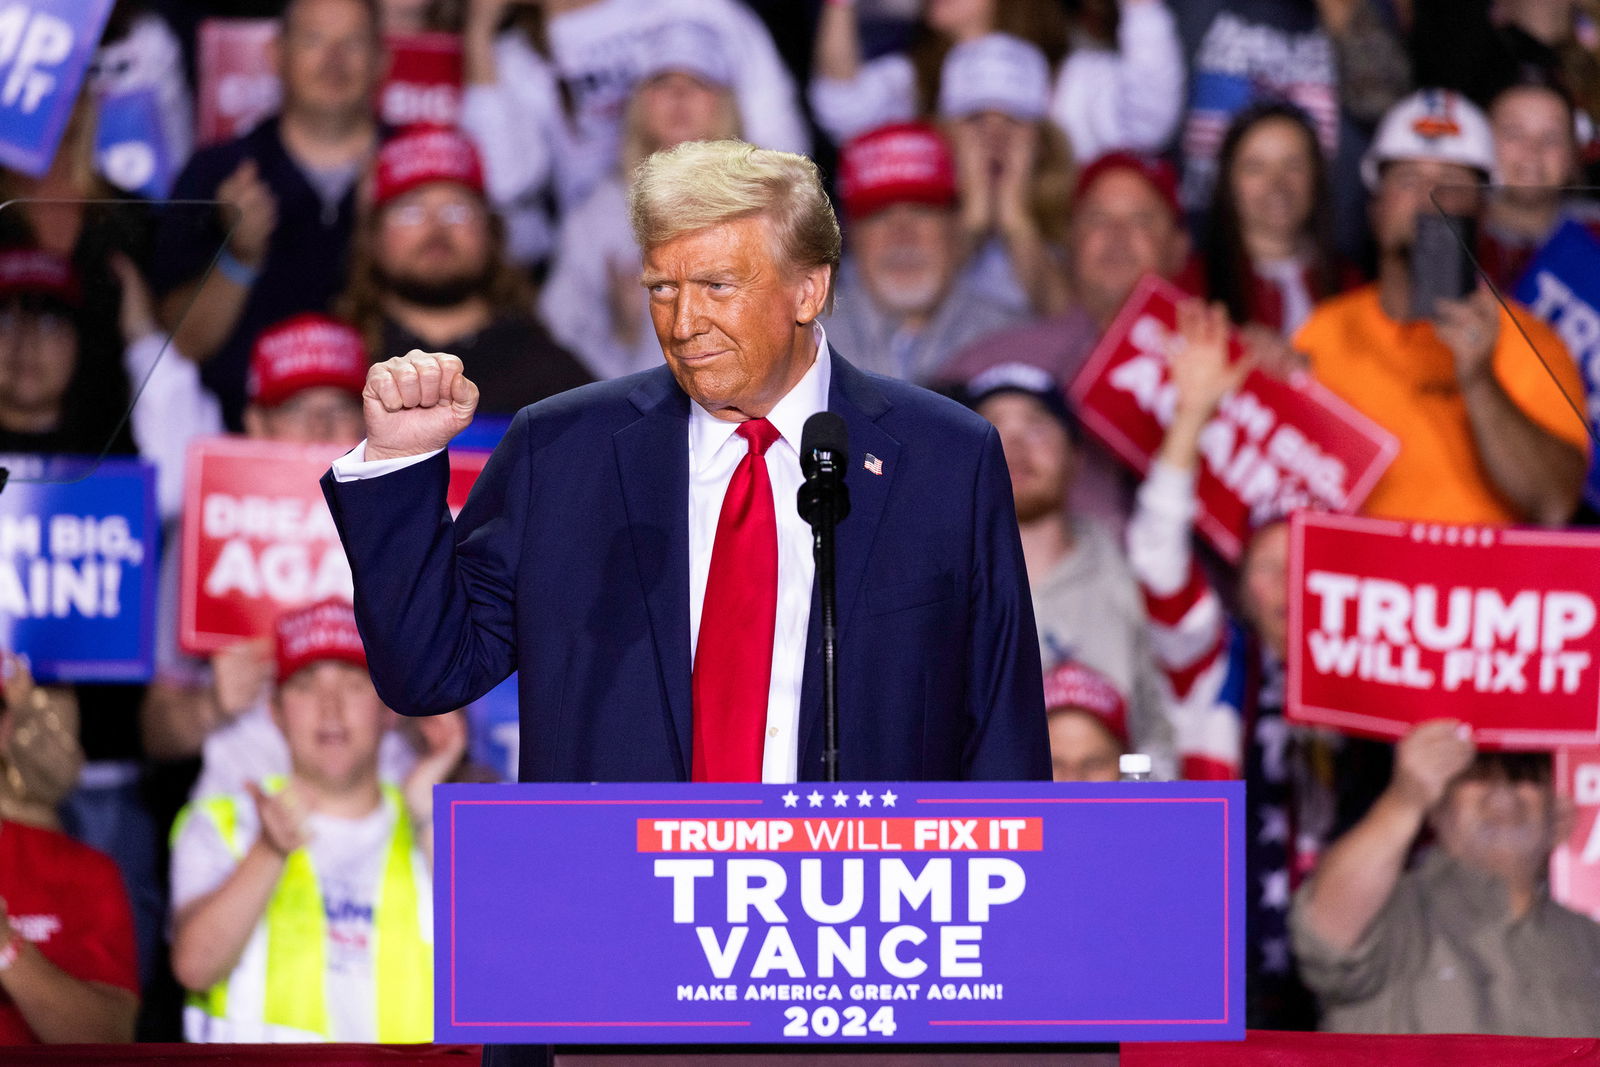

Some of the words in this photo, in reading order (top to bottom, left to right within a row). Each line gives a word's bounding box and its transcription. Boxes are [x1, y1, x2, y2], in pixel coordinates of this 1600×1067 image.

[49, 513, 145, 567] BIG,
[1305, 569, 1596, 653] TRUMP
[1307, 629, 1436, 690] WILL
[1442, 649, 1528, 694] FIX
[1537, 651, 1592, 694] IT
[653, 820, 794, 851] TRUMP
[803, 820, 902, 851] WILL
[914, 819, 979, 850] FIX
[989, 819, 1027, 850] IT
[653, 857, 1026, 924] TRUMP
[695, 924, 983, 979] VANCE
[677, 984, 738, 1001] MAKE
[744, 984, 843, 1001] AMERICA
[849, 984, 920, 1001] GREAT
[926, 983, 1003, 1000] AGAIN!
[783, 1005, 897, 1037] 2024
